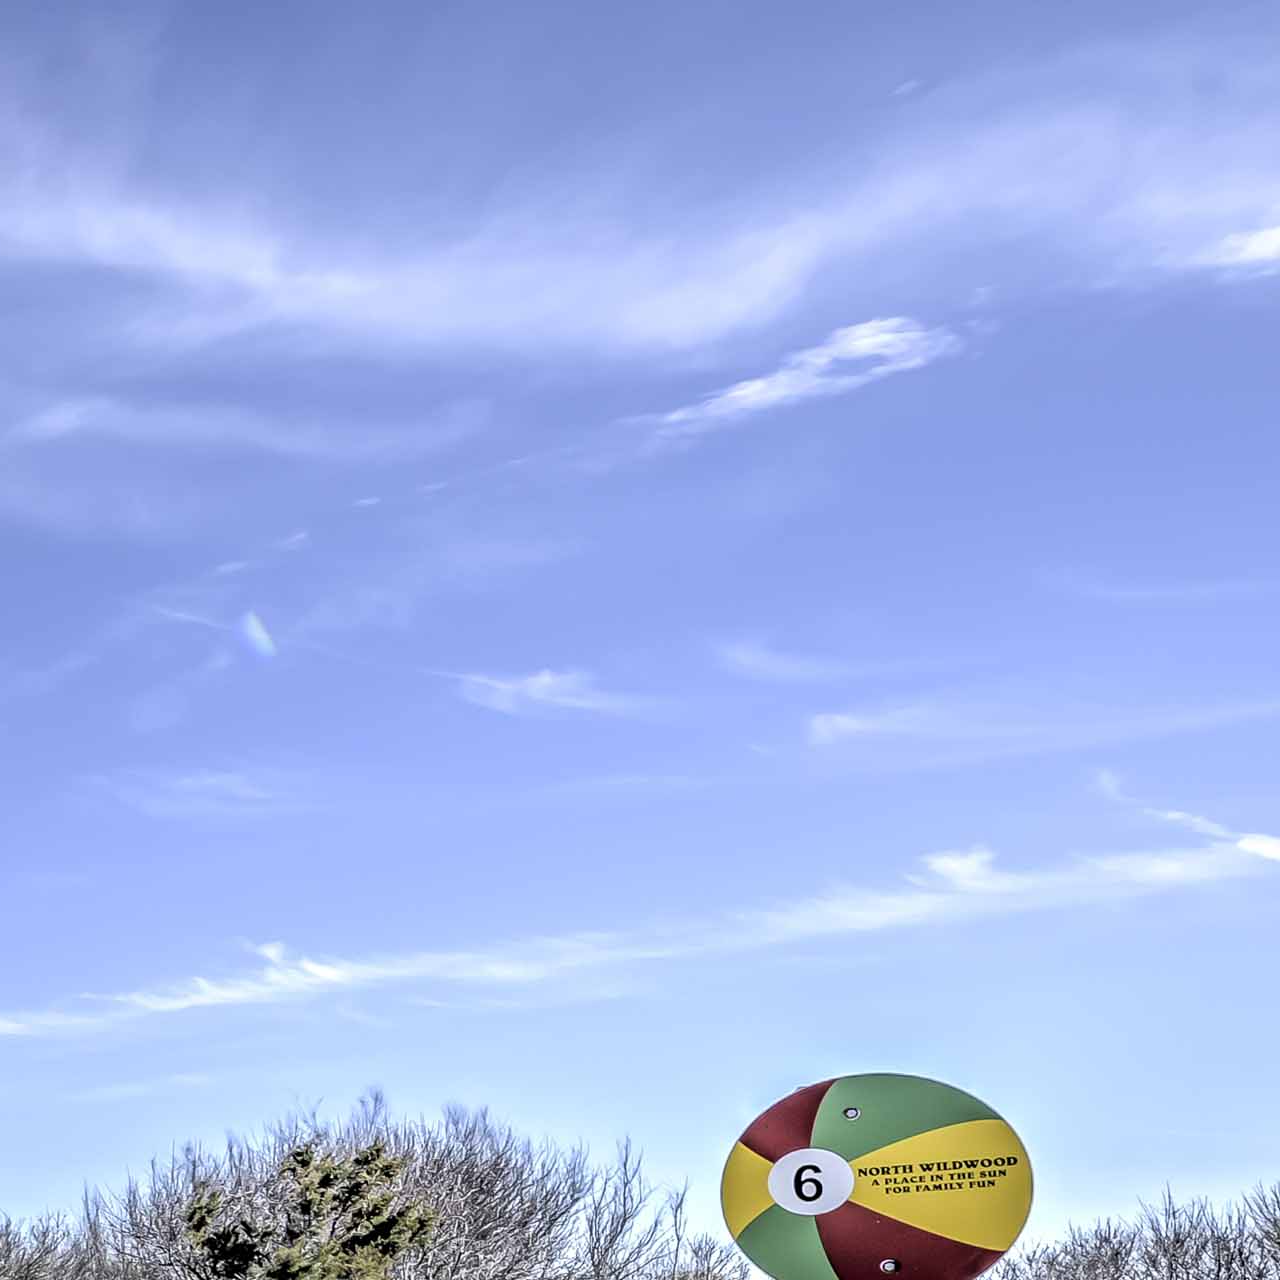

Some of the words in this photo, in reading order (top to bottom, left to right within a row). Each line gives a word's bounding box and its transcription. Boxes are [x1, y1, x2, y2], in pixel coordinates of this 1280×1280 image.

[858, 1165, 912, 1177] NORTH
[920, 1157, 1018, 1172] WILDWOOD
[793, 1165, 823, 1202] 6
[885, 1176, 925, 1185] PLACE
[949, 1172, 974, 1180] THE
[979, 1170, 1007, 1178] SUN
[916, 1182, 963, 1192] FAMILY
[969, 1180, 996, 1188] FUN
